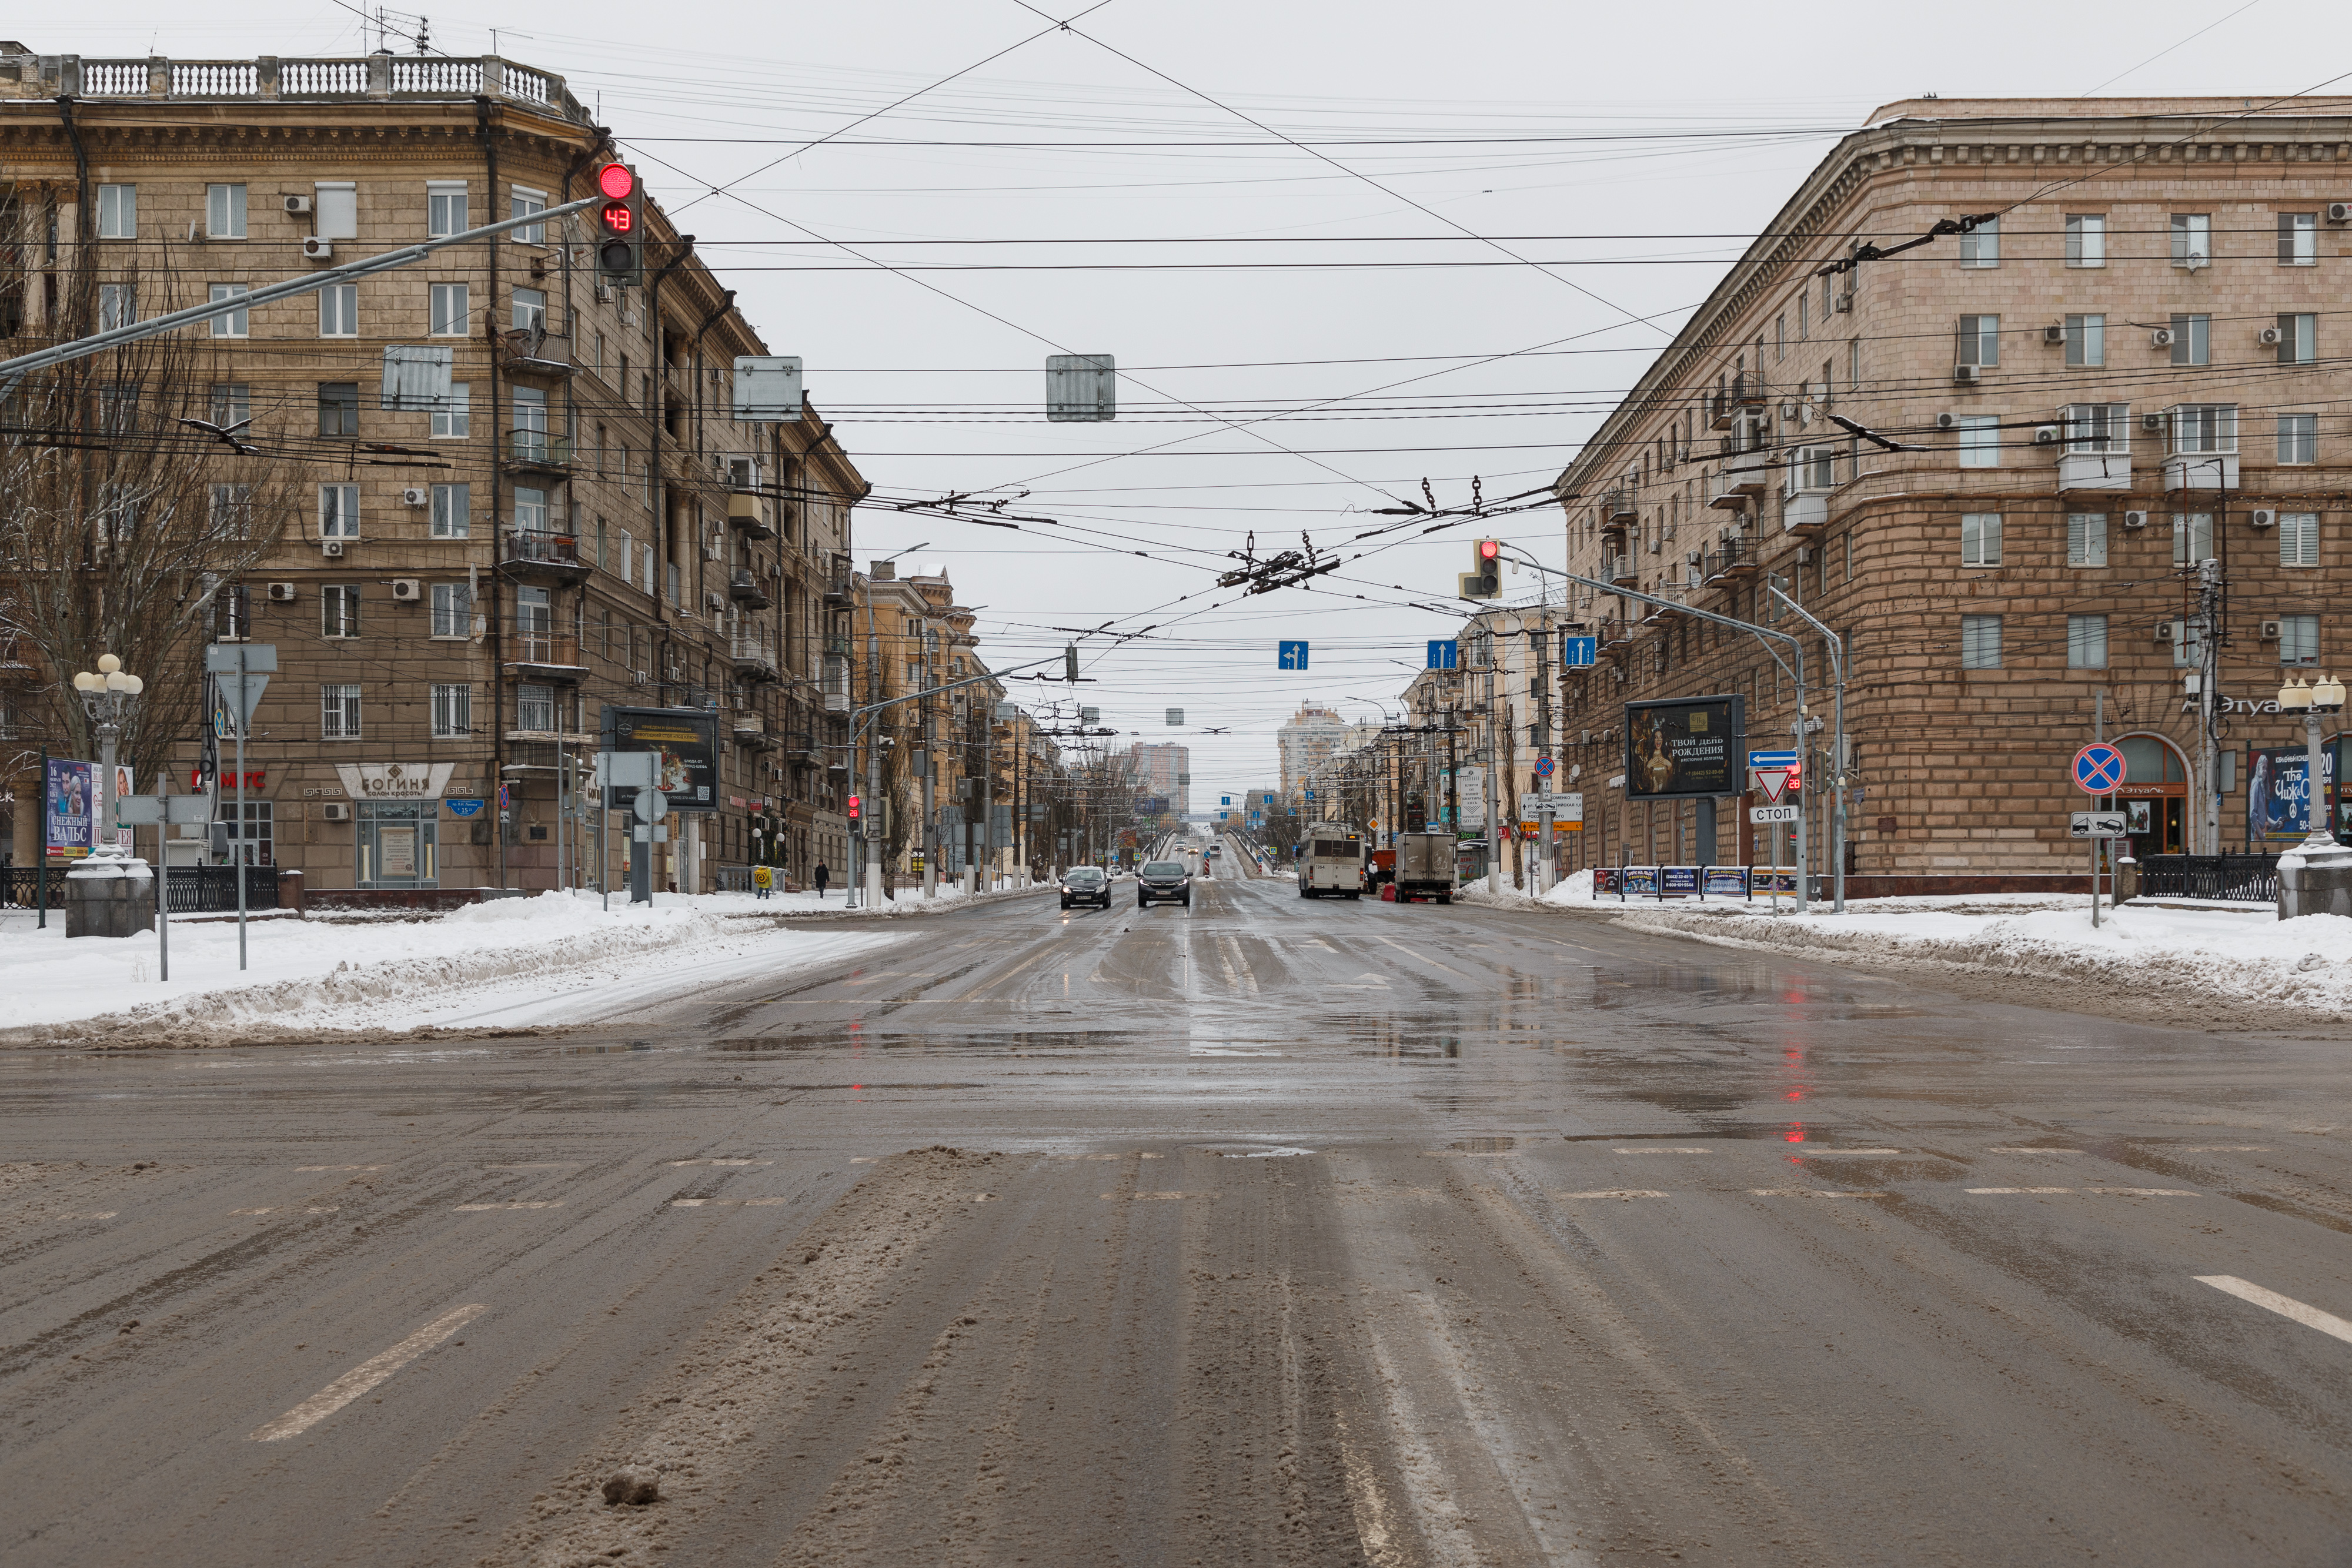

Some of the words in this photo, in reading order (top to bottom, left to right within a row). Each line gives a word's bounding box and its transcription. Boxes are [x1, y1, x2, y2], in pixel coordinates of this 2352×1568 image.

[606, 209, 630, 230] 43
[1671, 736, 1696, 747] ТВОЙ
[1699, 736, 1723, 746] ДЕНЬ
[1672, 746, 1723, 757] РОЖДЕНИЯ
[51, 766, 57, 777] 16
[2283, 767, 2303, 781] The
[220, 771, 266, 788] МТС
[362, 778, 429, 790] БОГИНЯ
[1788, 779, 1800, 788] 28
[849, 809, 858, 817] 28
[1756, 808, 1791, 820] СТОП
[52, 815, 88, 827] СНЕЖНЫЙ
[53, 825, 86, 846] ВАЛЬС
